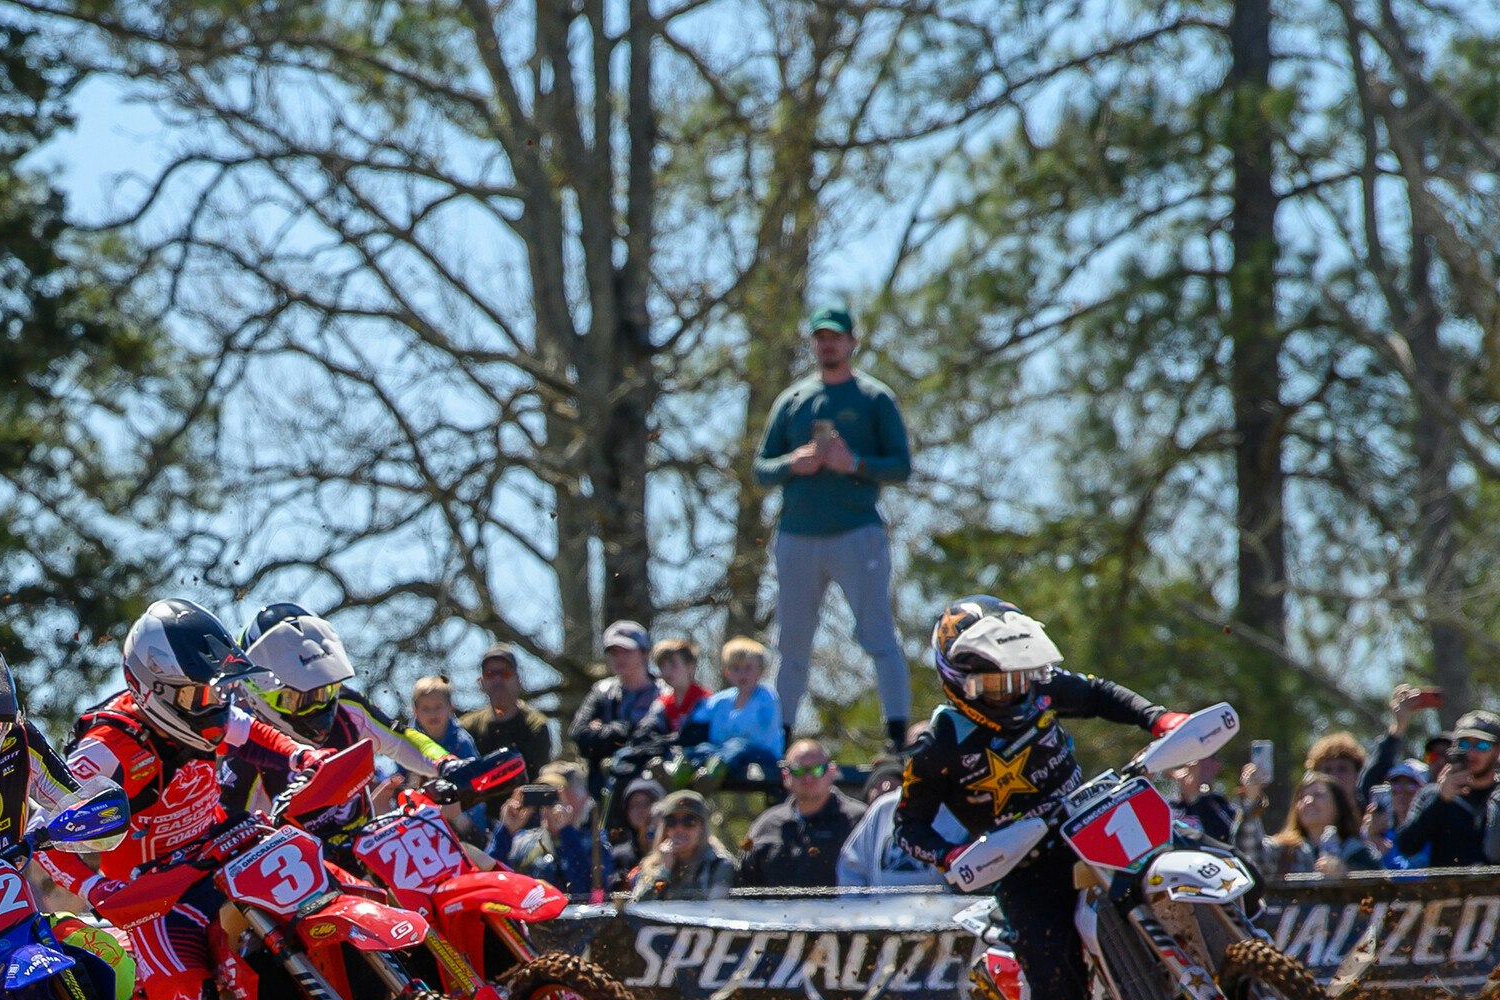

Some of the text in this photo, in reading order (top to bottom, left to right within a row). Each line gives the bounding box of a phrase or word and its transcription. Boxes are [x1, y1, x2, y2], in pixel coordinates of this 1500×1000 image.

[378, 818, 462, 891] 282
[1104, 800, 1154, 862] 1
[260, 843, 315, 905] 3
[1266, 896, 1500, 966] IALIZED
[24, 956, 61, 976] YAMAHA
